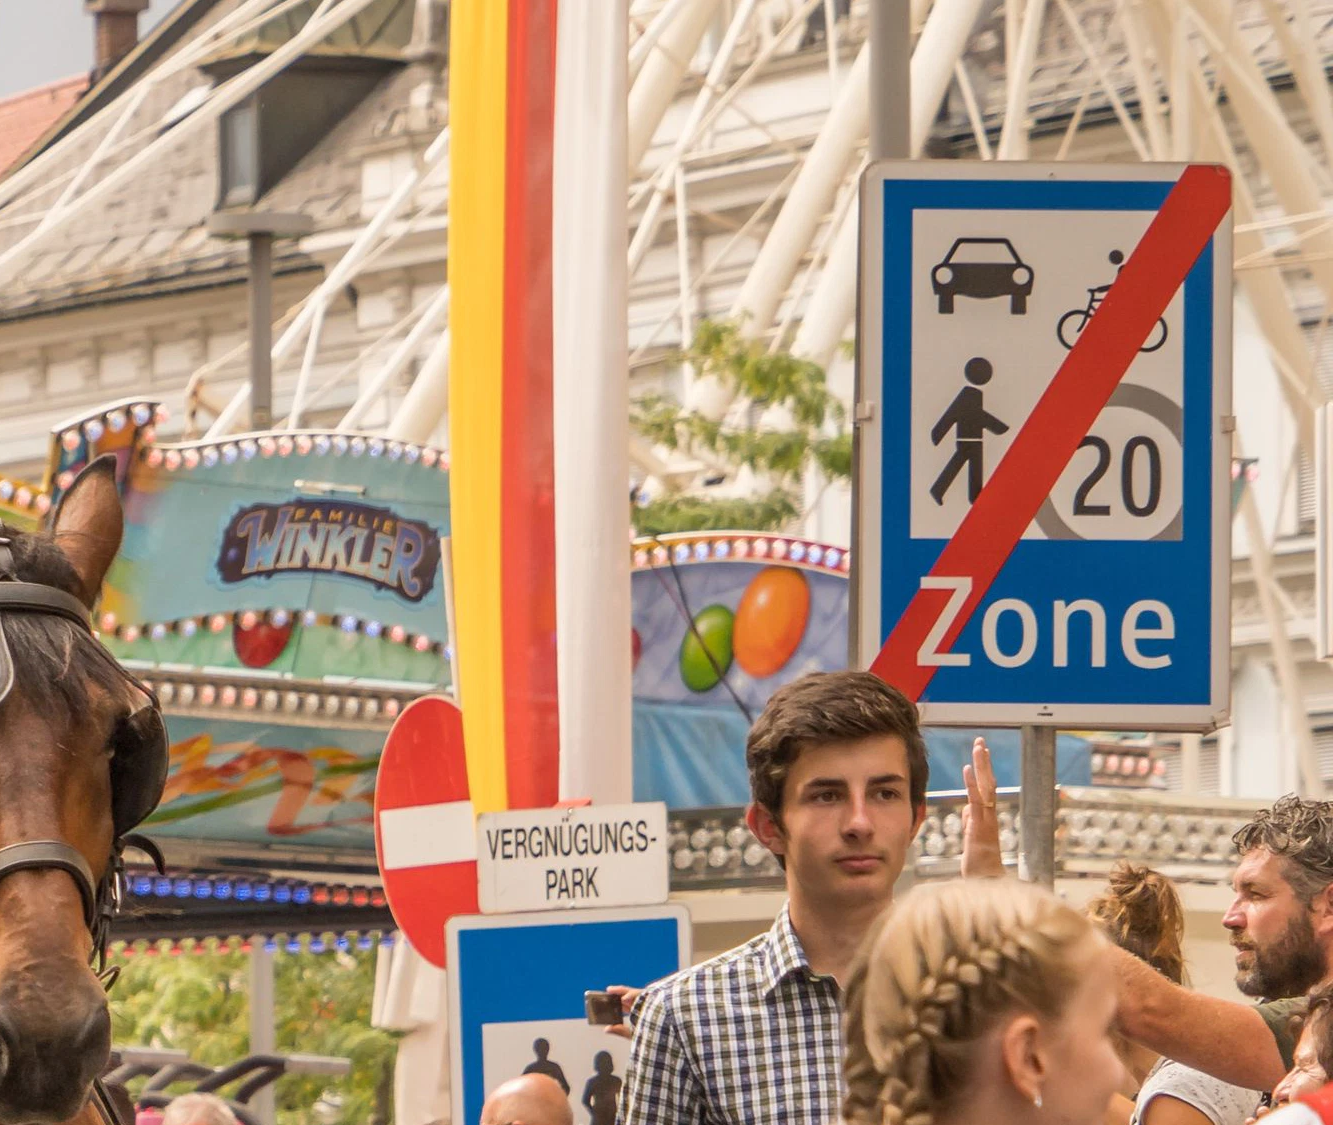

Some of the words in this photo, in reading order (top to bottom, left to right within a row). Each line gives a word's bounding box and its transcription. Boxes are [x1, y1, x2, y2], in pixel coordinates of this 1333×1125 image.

[1073, 435, 1162, 517] 20
[237, 506, 425, 598] WINKLER
[294, 508, 397, 534] FAMILIE
[916, 576, 1175, 669] Zone
[486, 817, 657, 860] VERGNÜGUNGS-
[546, 866, 600, 900] PARK
